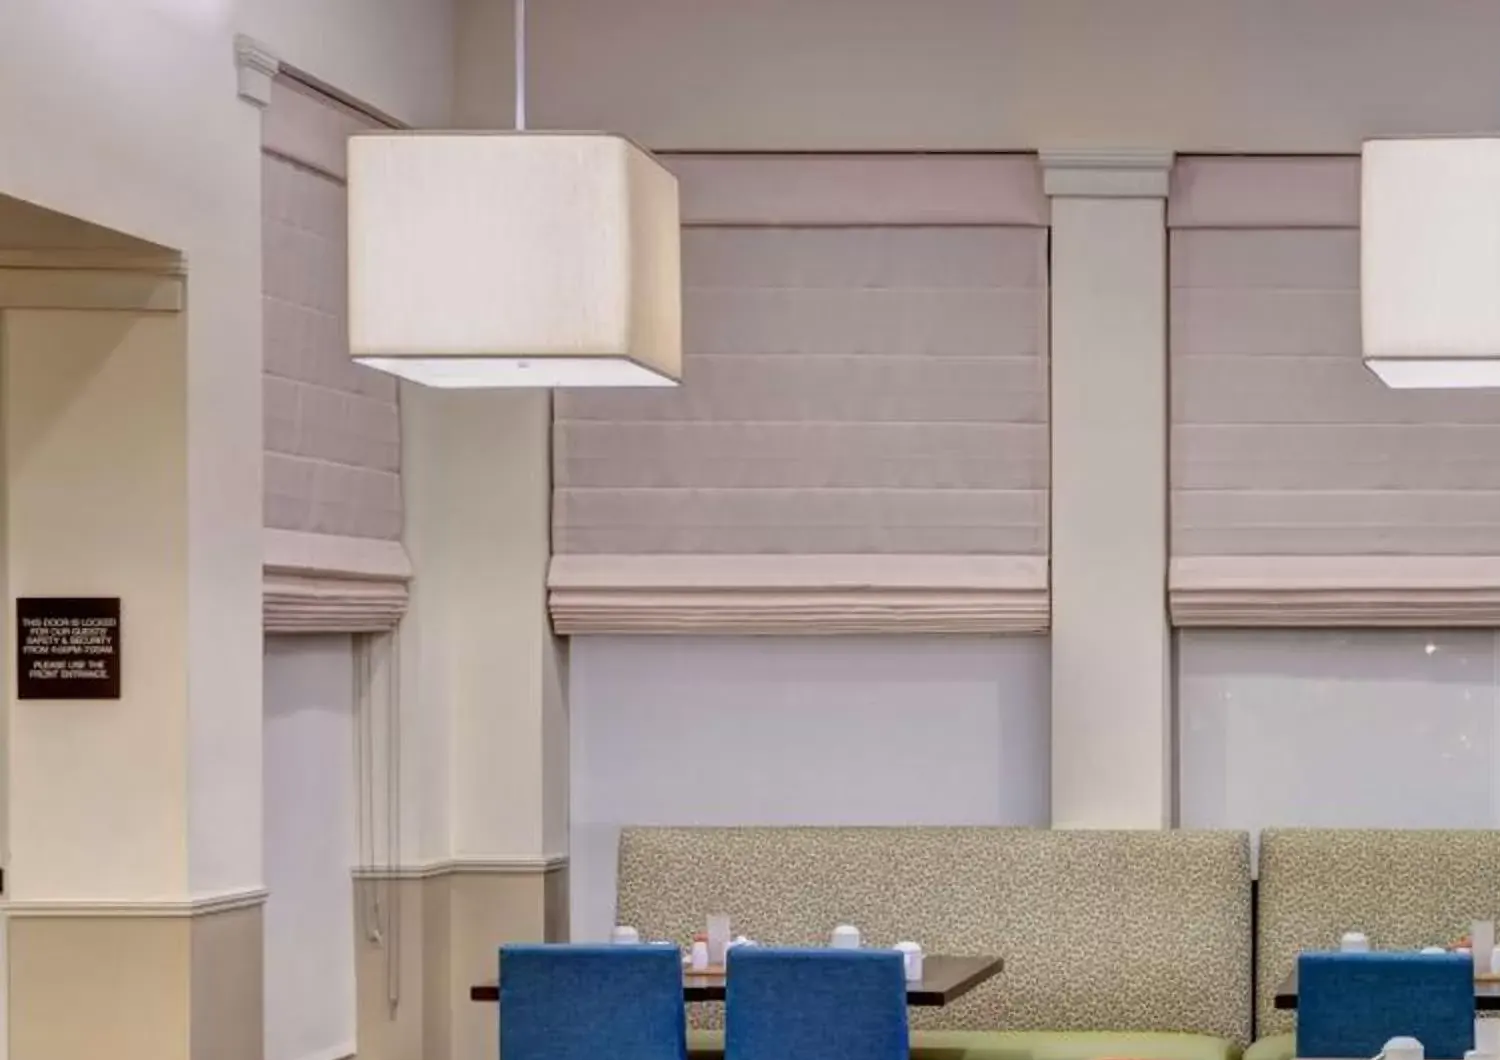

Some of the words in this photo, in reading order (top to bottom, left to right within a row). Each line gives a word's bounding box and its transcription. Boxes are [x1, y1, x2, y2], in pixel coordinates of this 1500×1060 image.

[43, 617, 69, 627] DOOR
[70, 617, 80, 627] IS
[81, 617, 116, 627] LOCKED
[29, 627, 49, 636] FOR
[26, 636, 60, 645] SAFETY
[69, 636, 112, 645] SECURITY
[23, 645, 49, 654] FROM
[33, 660, 66, 669] PLEASE
[88, 660, 106, 669] THE
[29, 669, 58, 679] FRONT
